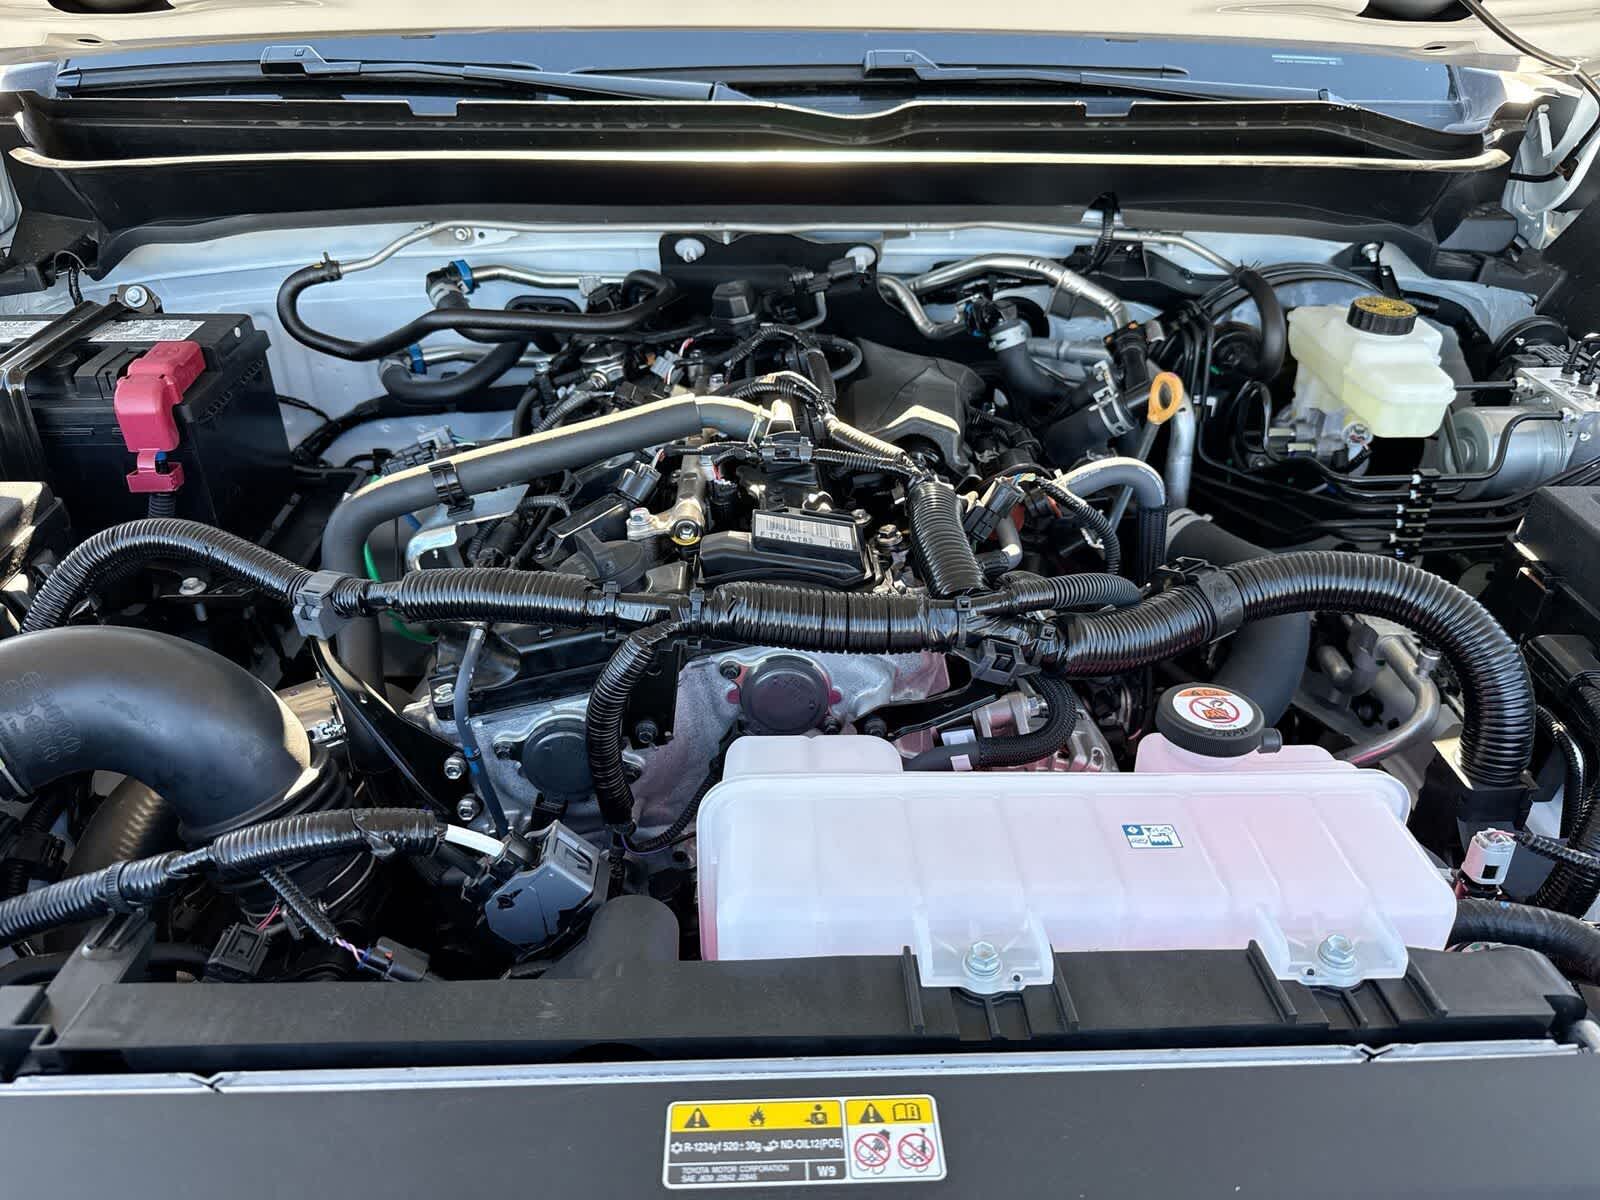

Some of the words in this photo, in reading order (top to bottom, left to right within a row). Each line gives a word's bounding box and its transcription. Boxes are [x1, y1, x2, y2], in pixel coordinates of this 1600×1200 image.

[683, 1141, 721, 1154] R-1234yf
[780, 1138, 843, 1151] ND-OIL12(POE)
[711, 1165, 738, 1174] MOTOR
[739, 1163, 790, 1173] CORPORATION
[816, 1165, 837, 1177] W9
